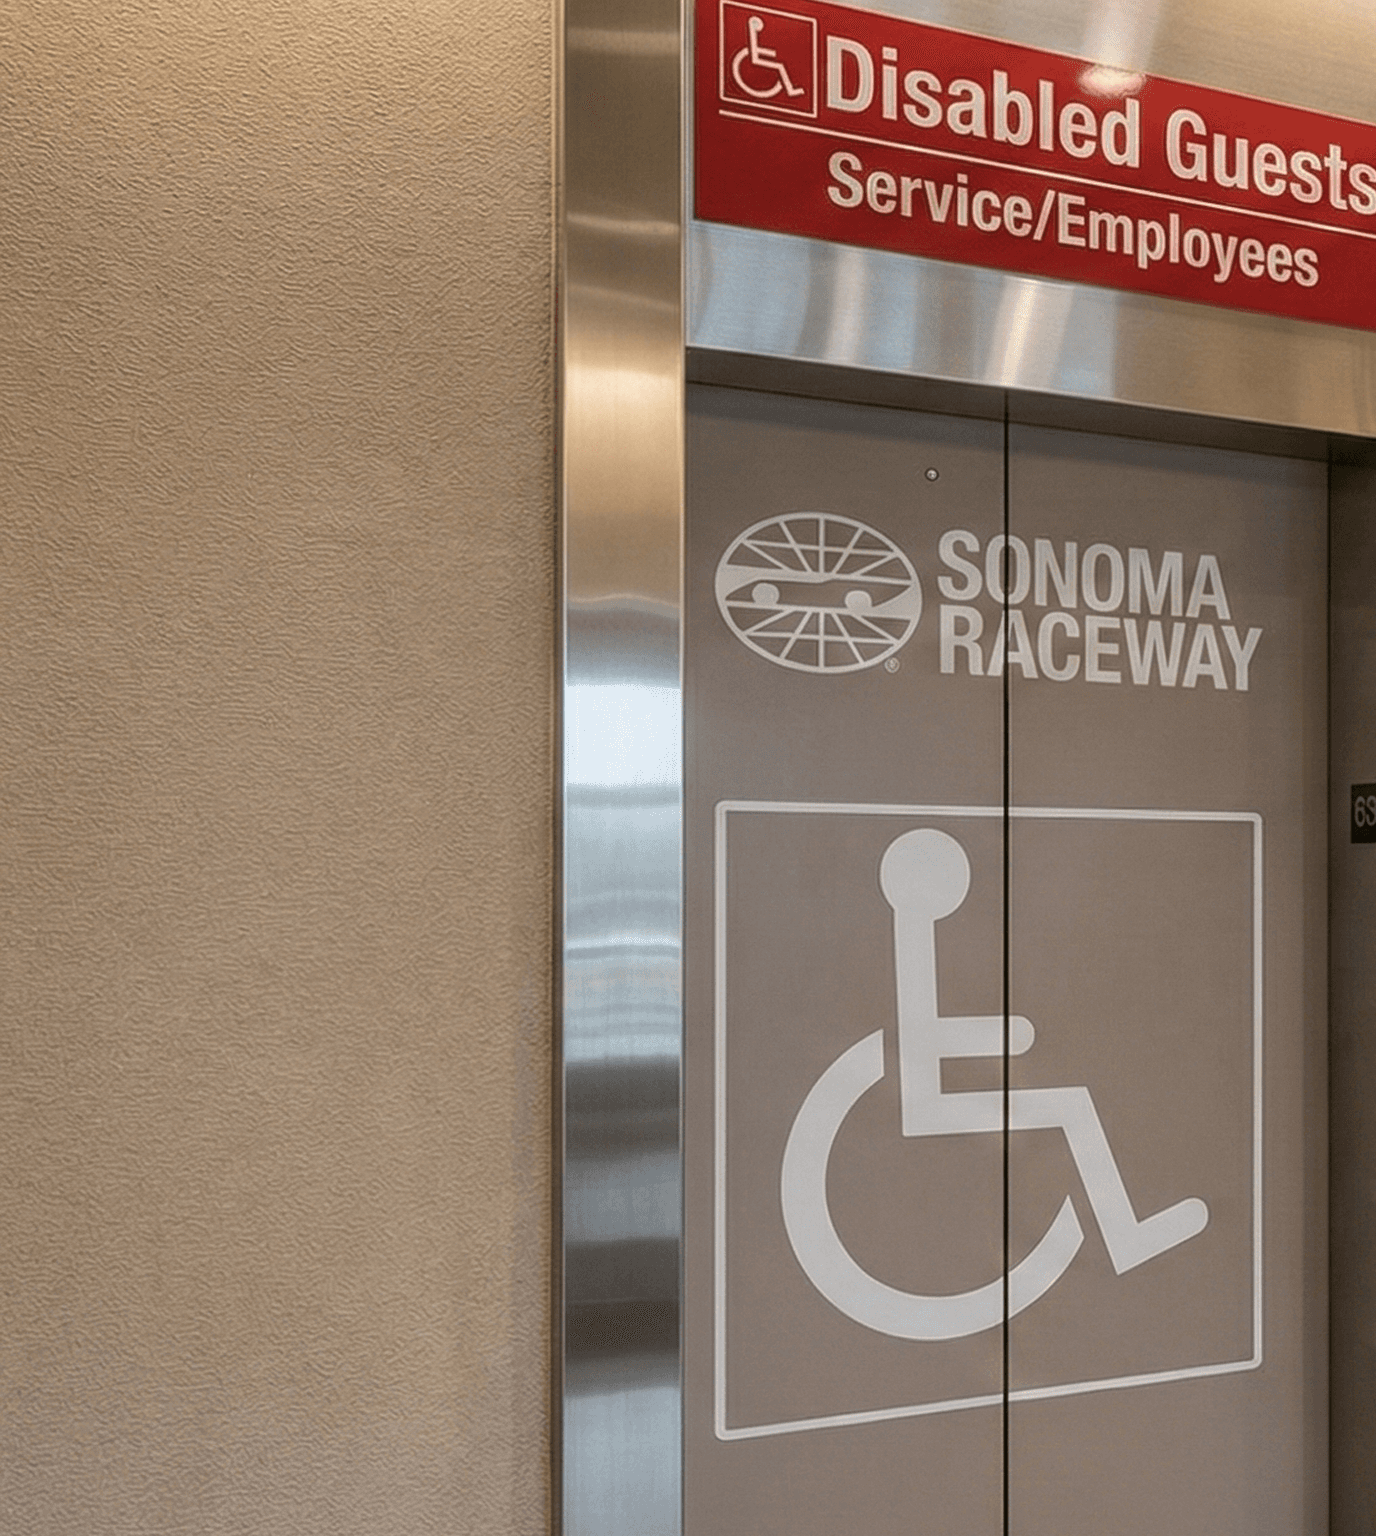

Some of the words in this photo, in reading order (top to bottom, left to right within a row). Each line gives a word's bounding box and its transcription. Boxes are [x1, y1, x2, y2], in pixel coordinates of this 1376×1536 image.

[825, 35, 1141, 169] Disabled
[826, 151, 1320, 287] Service/Employees
[936, 529, 1232, 620] SONOMA
[939, 604, 1263, 692] RACEWAY
